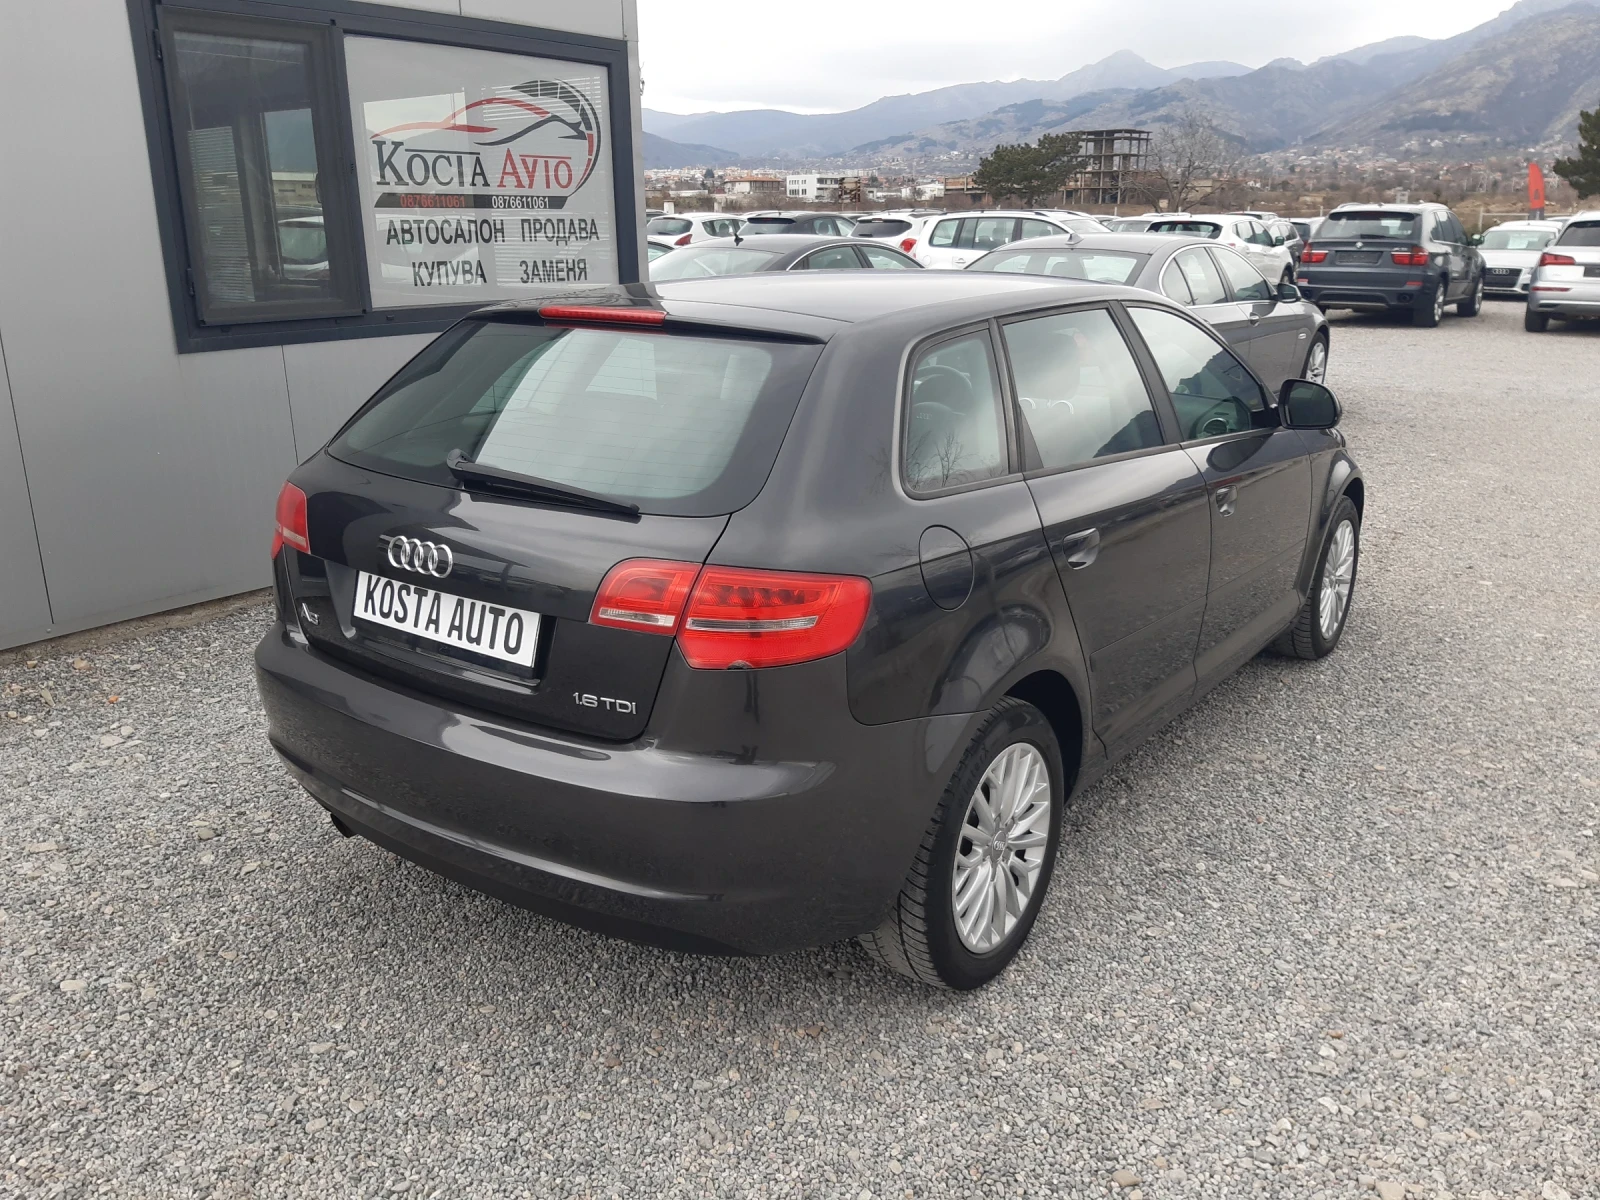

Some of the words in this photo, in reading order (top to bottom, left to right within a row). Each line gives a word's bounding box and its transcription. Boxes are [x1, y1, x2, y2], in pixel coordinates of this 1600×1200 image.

[491, 196, 550, 209] 0876611061
[386, 219, 505, 245] АВТОСАЛОН
[520, 218, 600, 246] ПРОДАВА
[411, 260, 488, 287] КУПУВА
[519, 258, 588, 284] ЗАМЕНЯ
[363, 574, 440, 635] KOSTA
[450, 598, 524, 656] AUTO
[573, 692, 598, 708] 1.6
